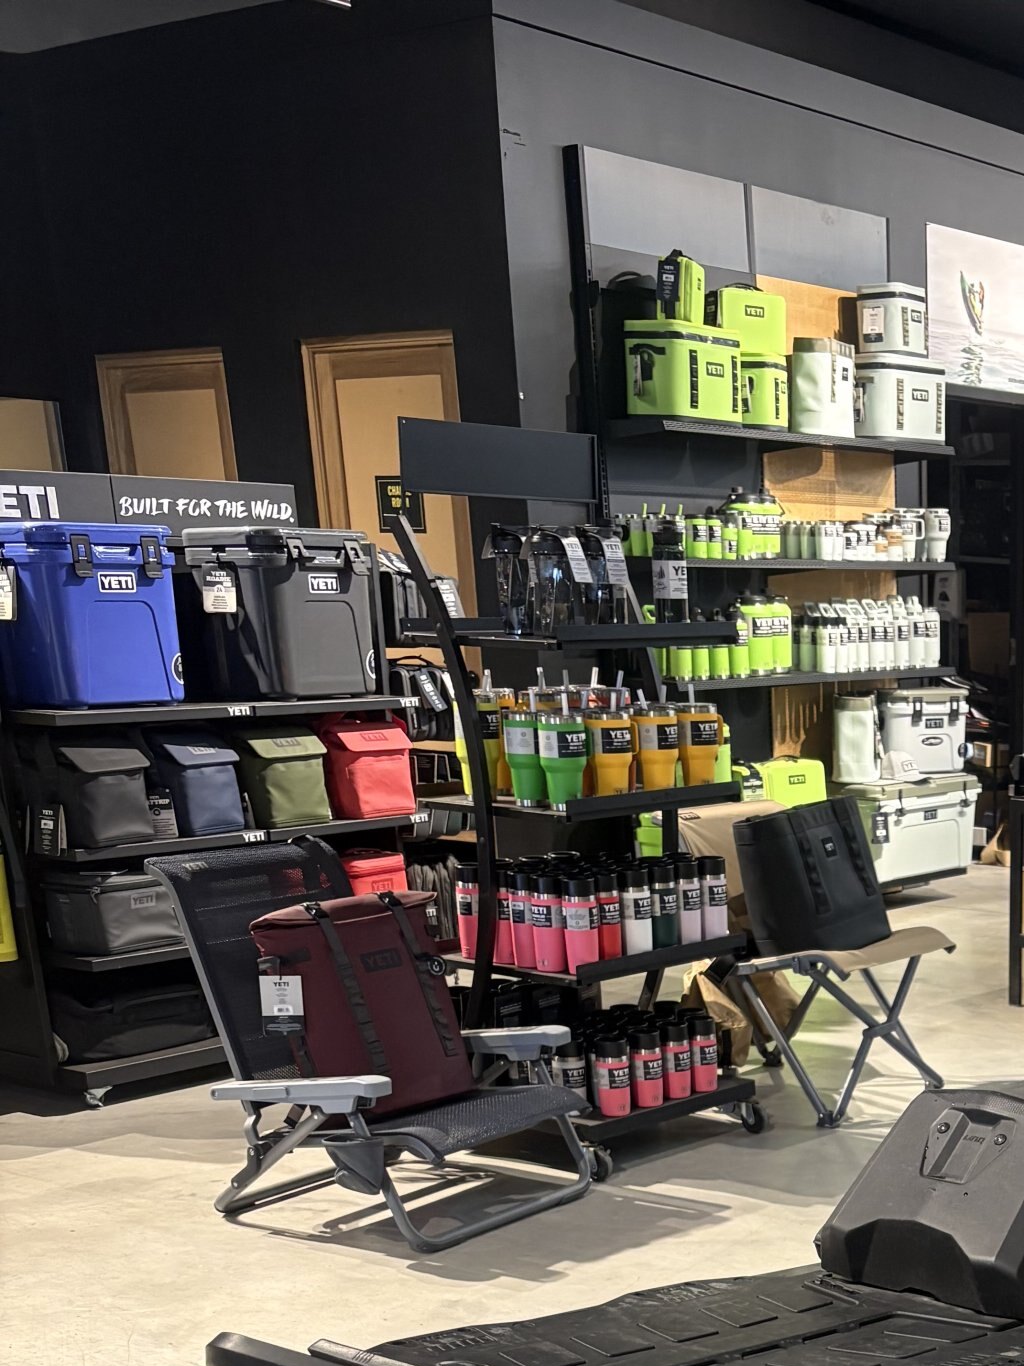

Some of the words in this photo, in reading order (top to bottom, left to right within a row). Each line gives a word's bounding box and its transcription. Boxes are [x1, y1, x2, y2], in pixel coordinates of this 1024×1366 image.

[745, 307, 764, 316] YETI
[706, 364, 724, 375] YETI
[912, 390, 928, 401] YETI
[0, 484, 60, 519] ETI
[118, 496, 176, 516] BUILT
[176, 499, 211, 517] FOR
[214, 500, 249, 518] THE
[250, 499, 296, 523] WILD.
[565, 543, 580, 551] YETI
[605, 543, 621, 551] YETI
[672, 565, 687, 576] YE
[101, 576, 133, 591] YETI
[311, 579, 337, 591] YETI
[400, 697, 420, 707] YETI
[227, 706, 251, 716] YETI
[409, 813, 429, 823] YETI
[242, 832, 265, 842] YETI
[373, 880, 393, 891] YETI
[132, 896, 154, 905] YETI
